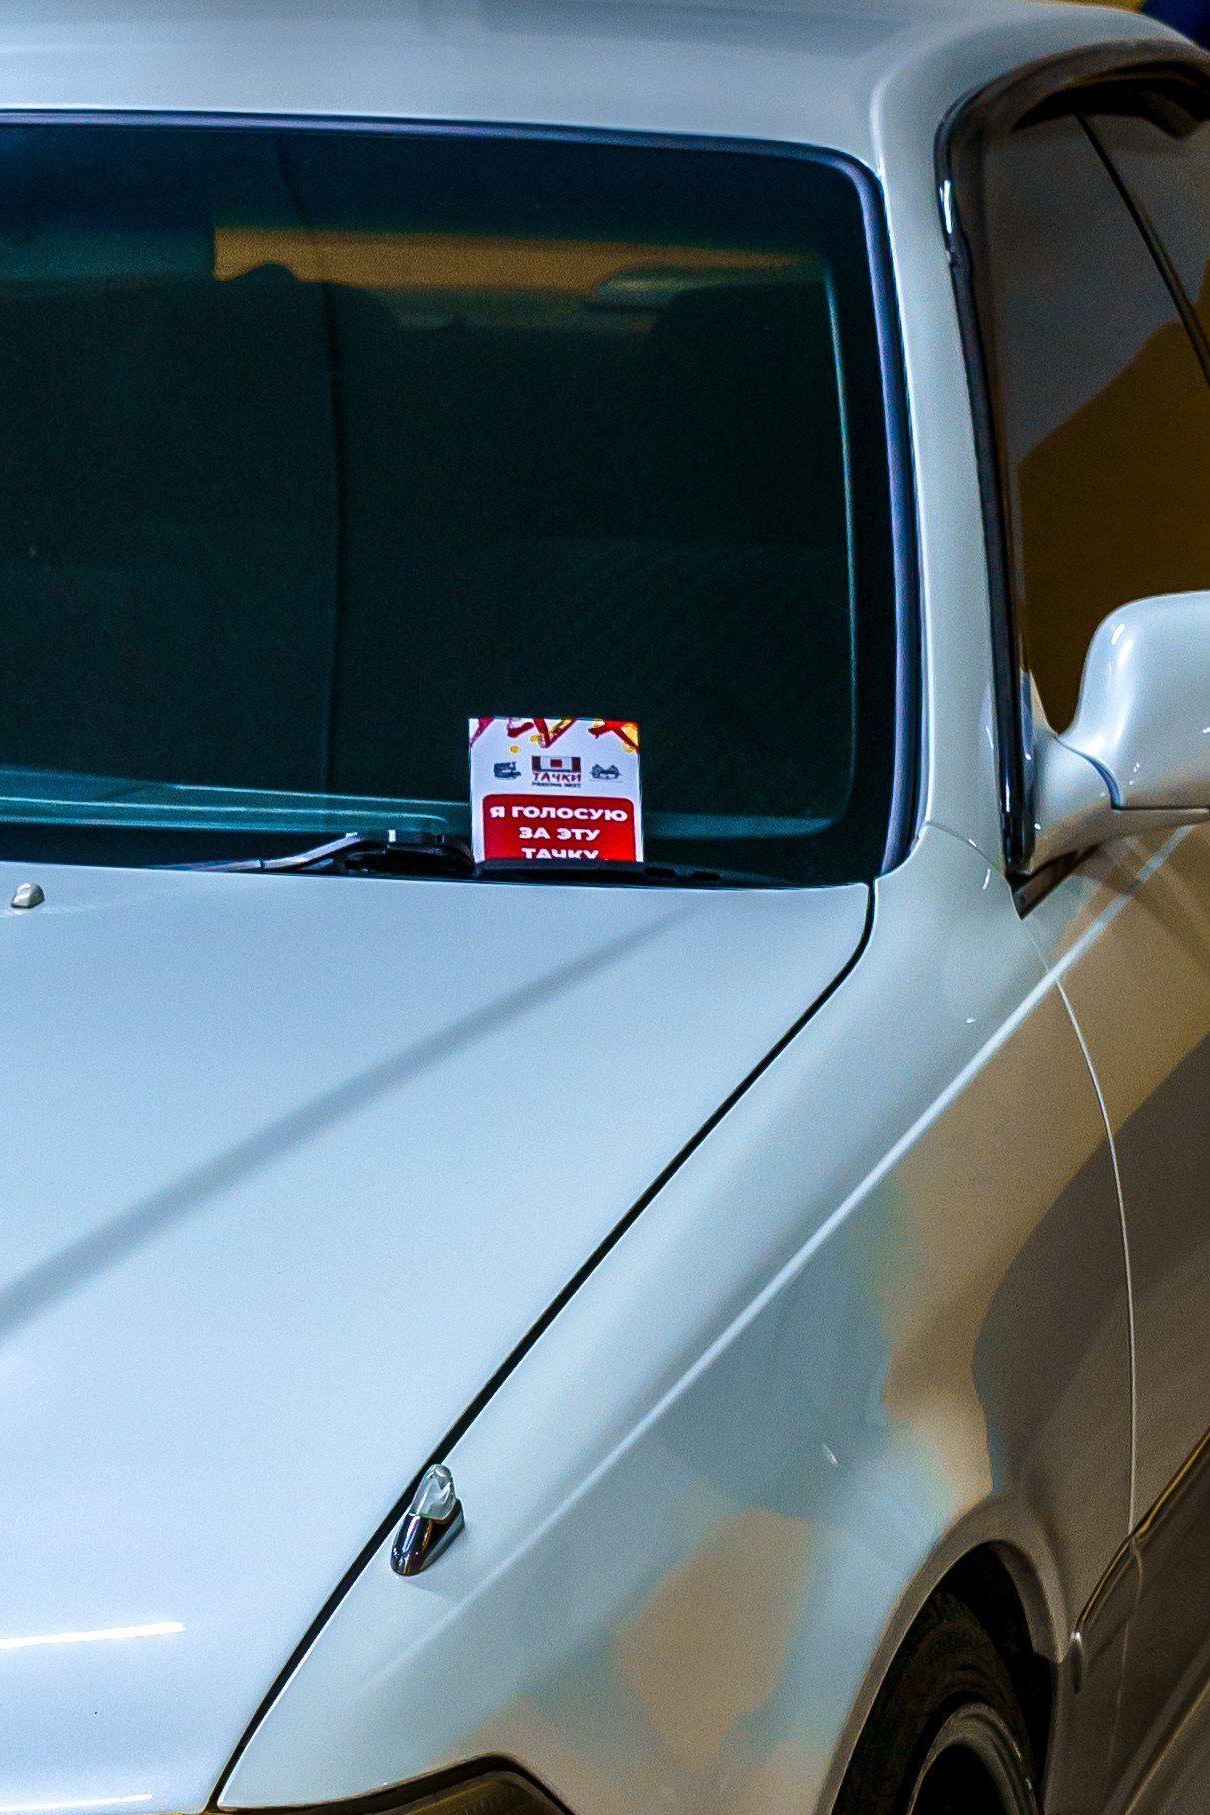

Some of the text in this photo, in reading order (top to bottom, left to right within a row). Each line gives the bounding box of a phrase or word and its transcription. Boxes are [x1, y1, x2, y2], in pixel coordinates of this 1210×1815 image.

[532, 772, 582, 783] ТАЧКИ
[490, 806, 628, 822] Я ГОЛОСУЮ
[519, 827, 601, 841] ЗА ЭТУ
